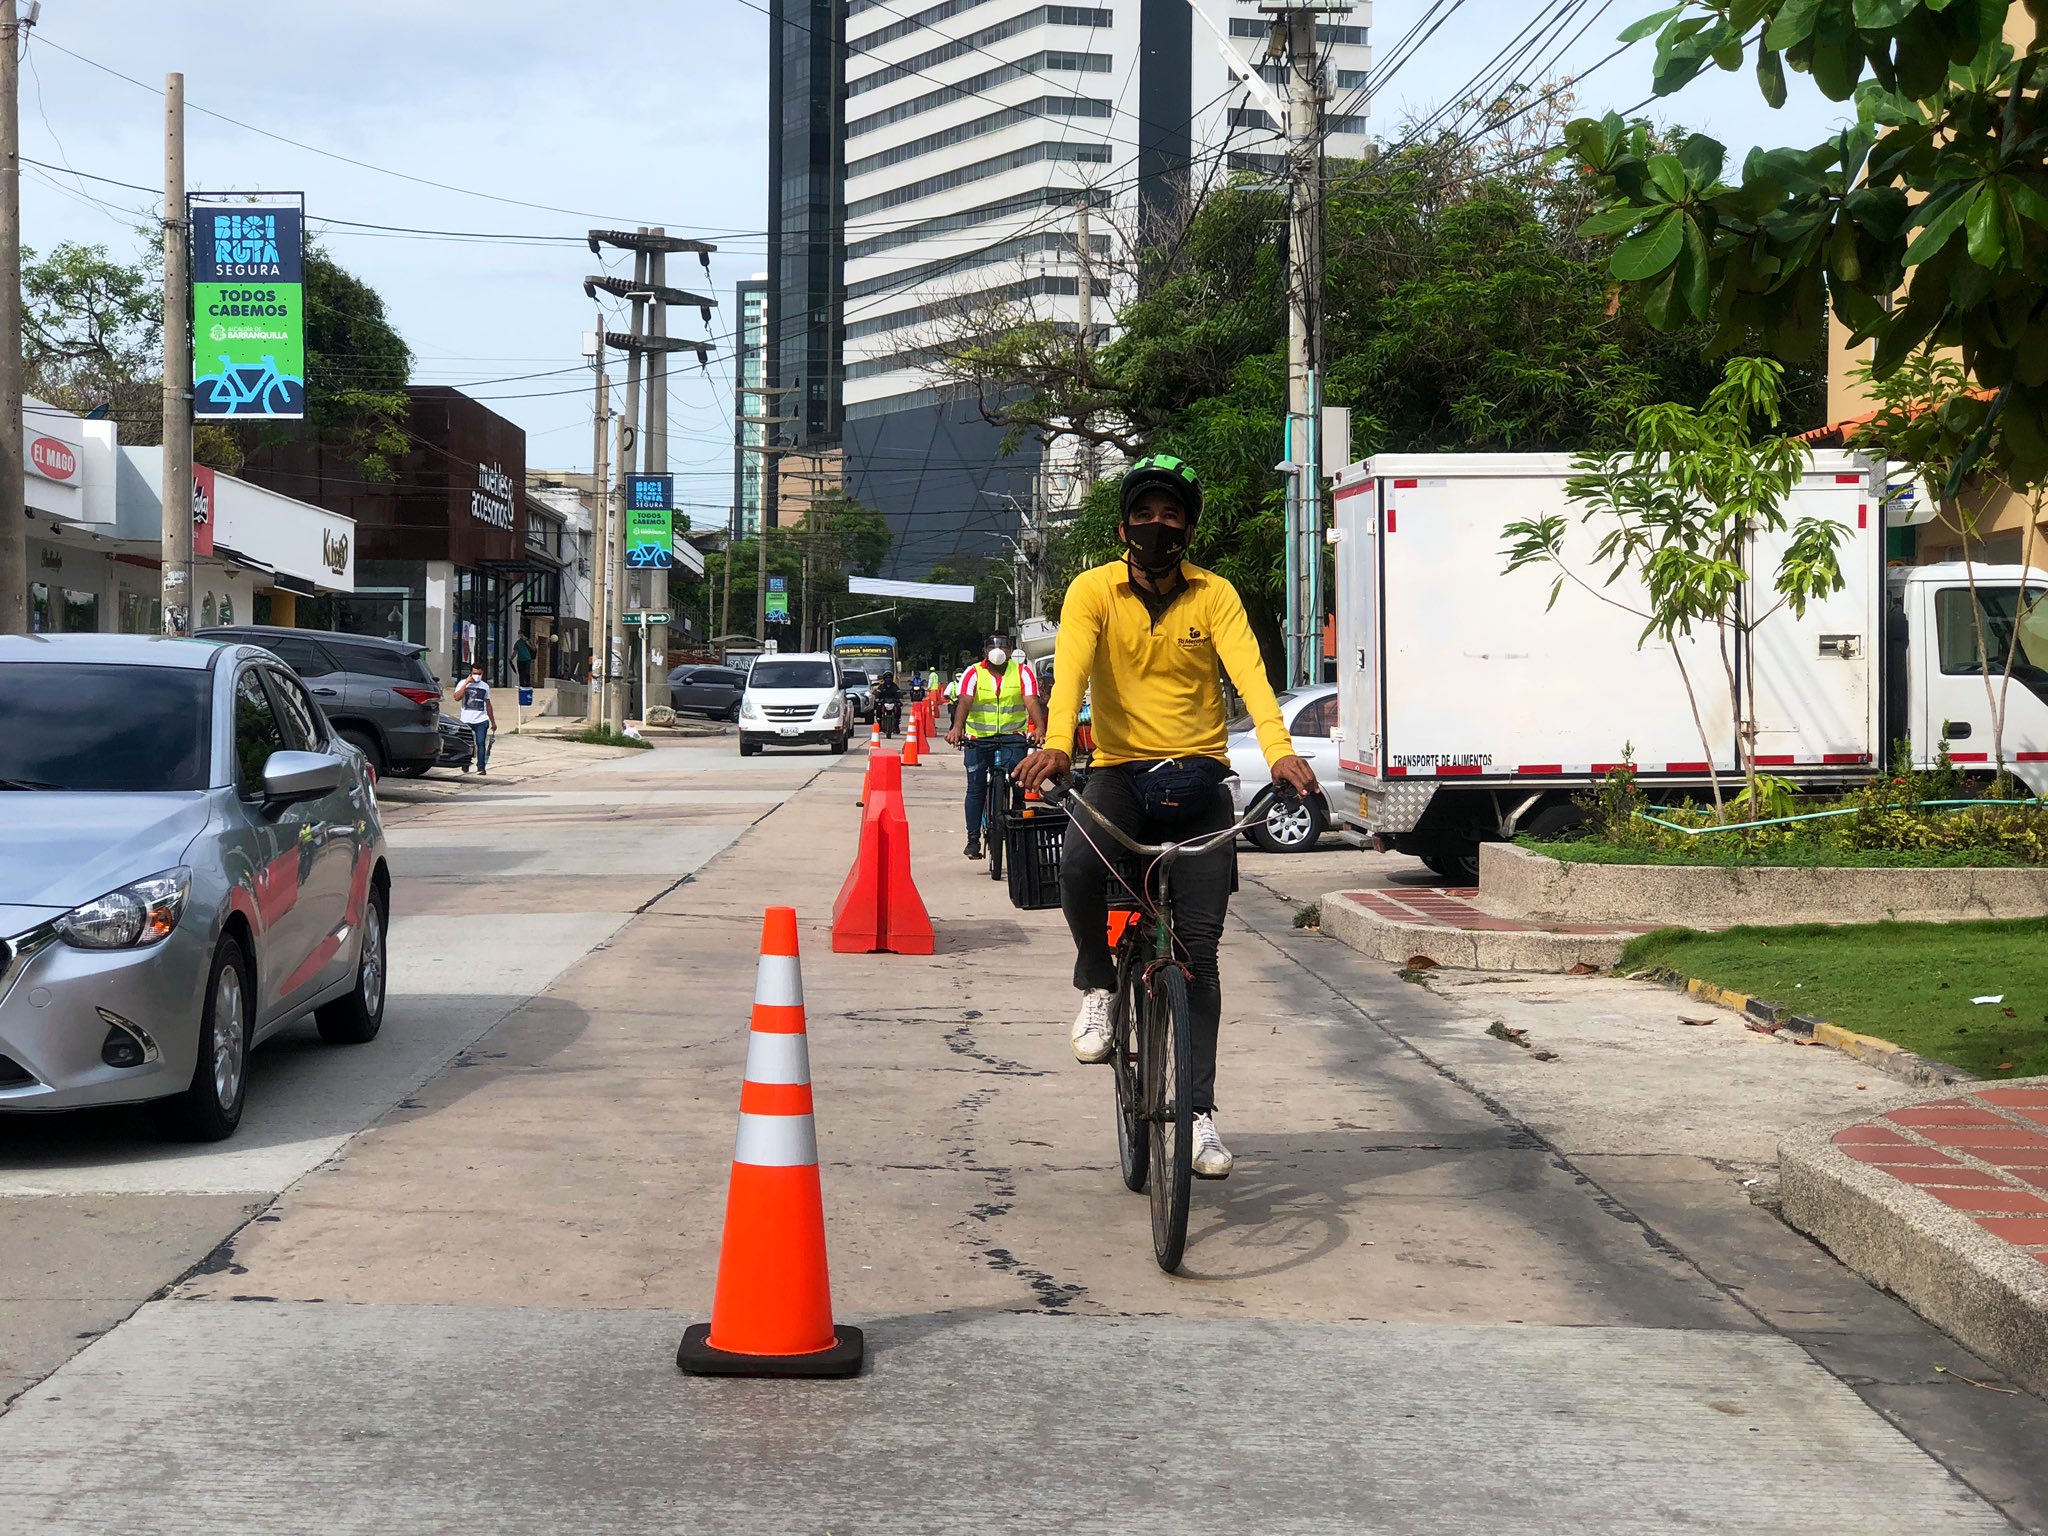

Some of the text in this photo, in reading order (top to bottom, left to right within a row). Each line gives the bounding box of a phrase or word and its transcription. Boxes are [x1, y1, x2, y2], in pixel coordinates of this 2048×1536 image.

[214, 215, 275, 239] BICI
[215, 240, 280, 263] RUTA
[216, 264, 280, 276] SEGURA
[219, 290, 276, 302] TODOS
[208, 305, 288, 317] CABEMOS
[228, 331, 288, 340] BARRANQUILLA
[34, 443, 74, 472] EL MAGO
[478, 461, 508, 499] muebles
[635, 481, 662, 492] BICI
[1393, 753, 1493, 767] TRANSPORTE DE ALIMENTOS
